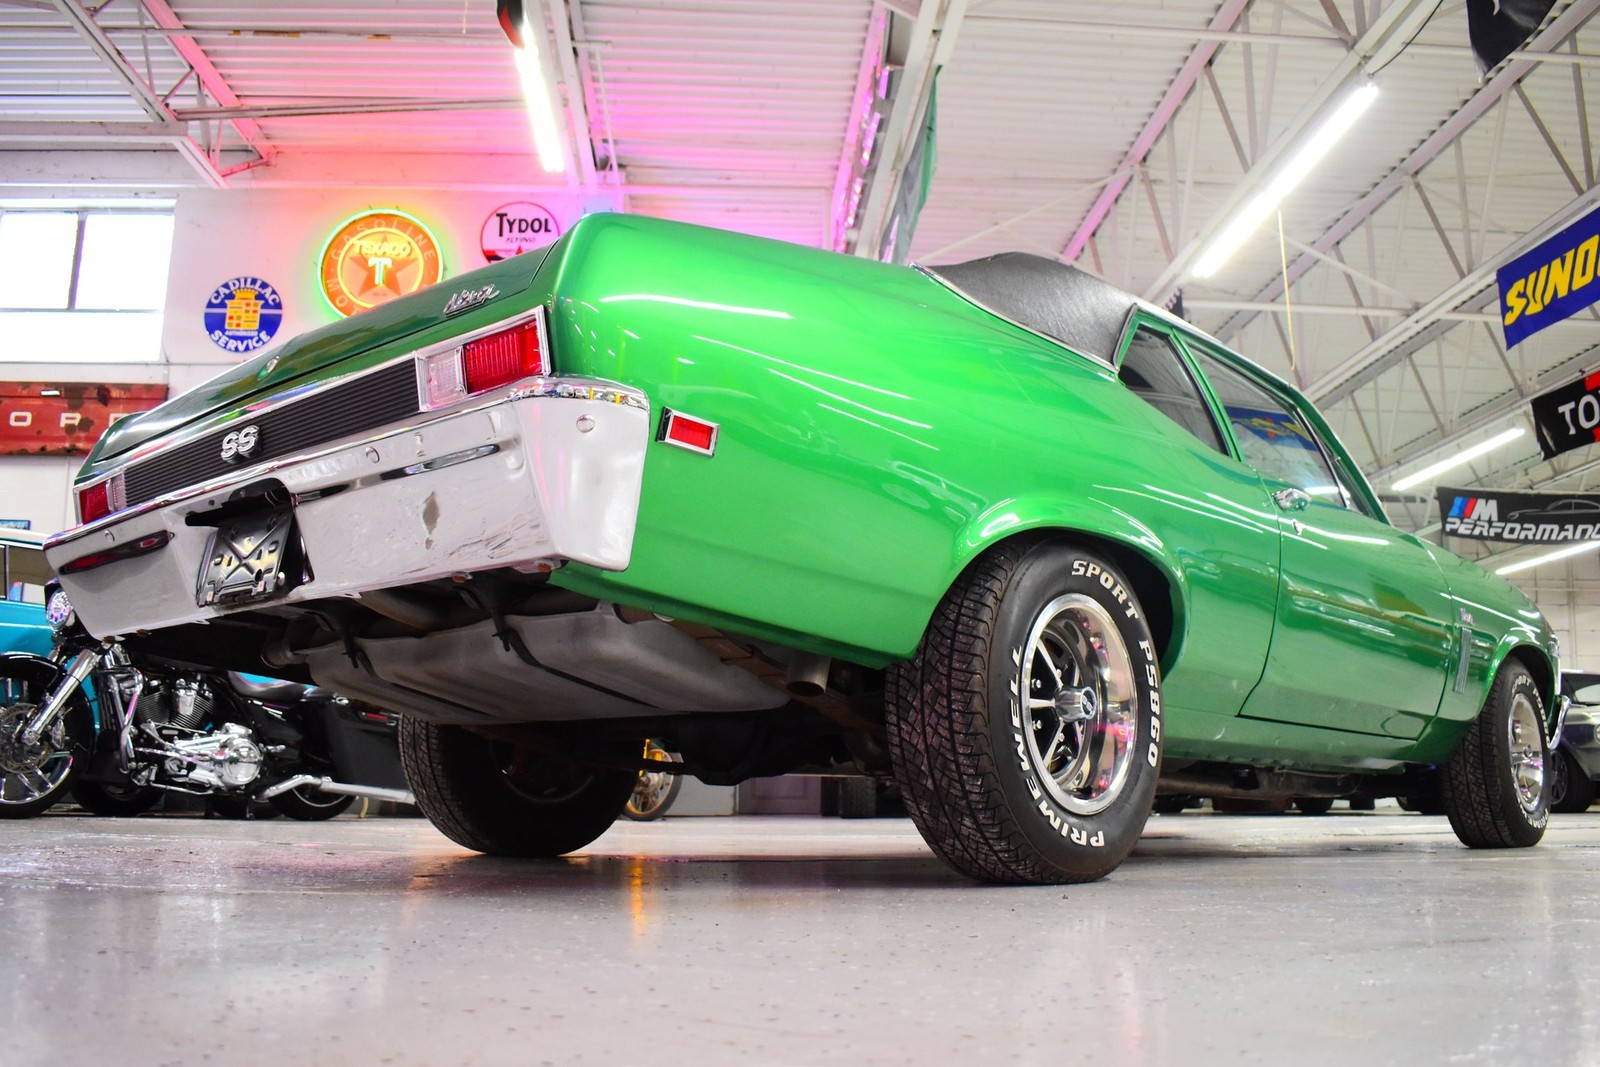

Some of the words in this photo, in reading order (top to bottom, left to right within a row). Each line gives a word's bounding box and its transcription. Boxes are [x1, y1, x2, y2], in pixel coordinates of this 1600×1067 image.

[332, 219, 436, 261] GASOLINE
[496, 213, 552, 237] TYDOL
[211, 277, 280, 306] CADILLAC
[1504, 234, 1600, 326] SUNO
[210, 329, 271, 352] SERVICE
[1558, 389, 1600, 435] TO
[221, 424, 259, 463] SS
[1470, 498, 1499, 521] M
[1009, 645, 1105, 848] PRIMEWELL
[1071, 560, 1140, 620] SPORT
[1138, 639, 1161, 768] PS860
